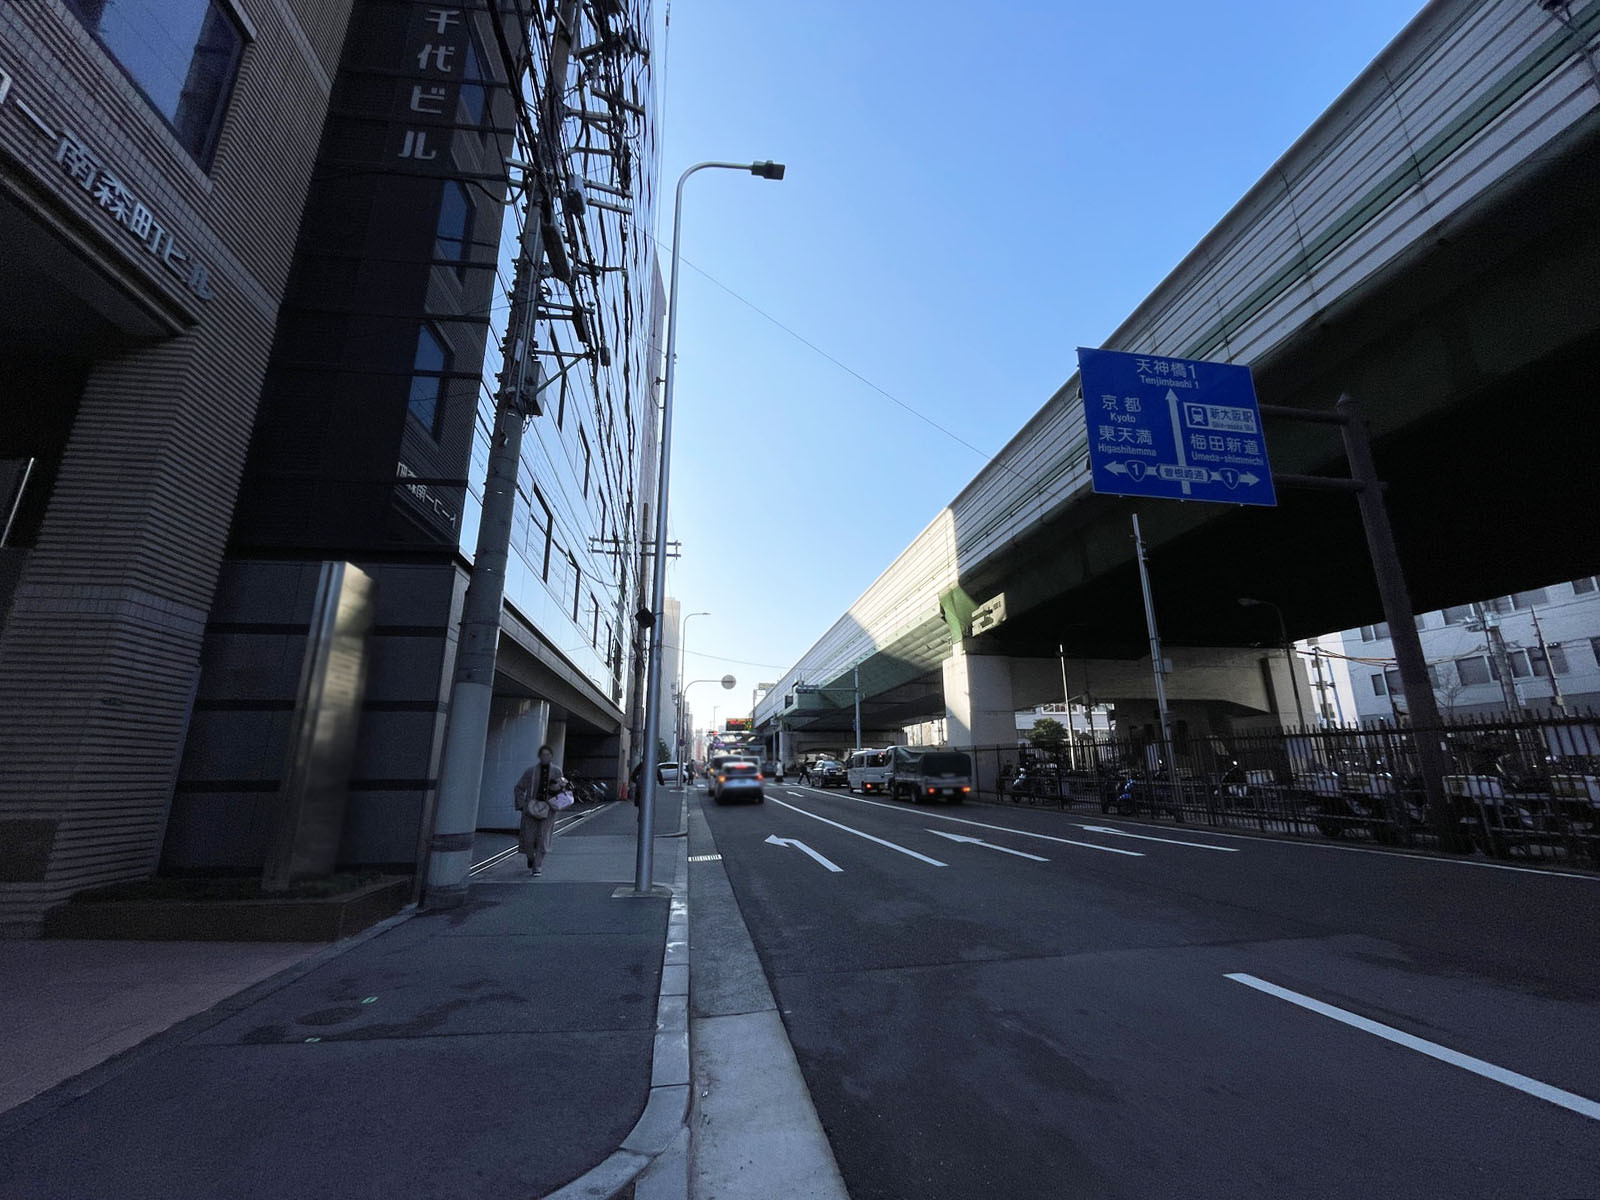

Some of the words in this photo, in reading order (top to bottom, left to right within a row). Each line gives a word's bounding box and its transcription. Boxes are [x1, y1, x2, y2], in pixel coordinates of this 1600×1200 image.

[1110, 412, 1136, 424] Kyoto
[1098, 425, 1153, 445] 東天満
[1190, 433, 1262, 455] 梅田新道
[1132, 463, 1140, 476] 1
[1226, 471, 1233, 484] 1
